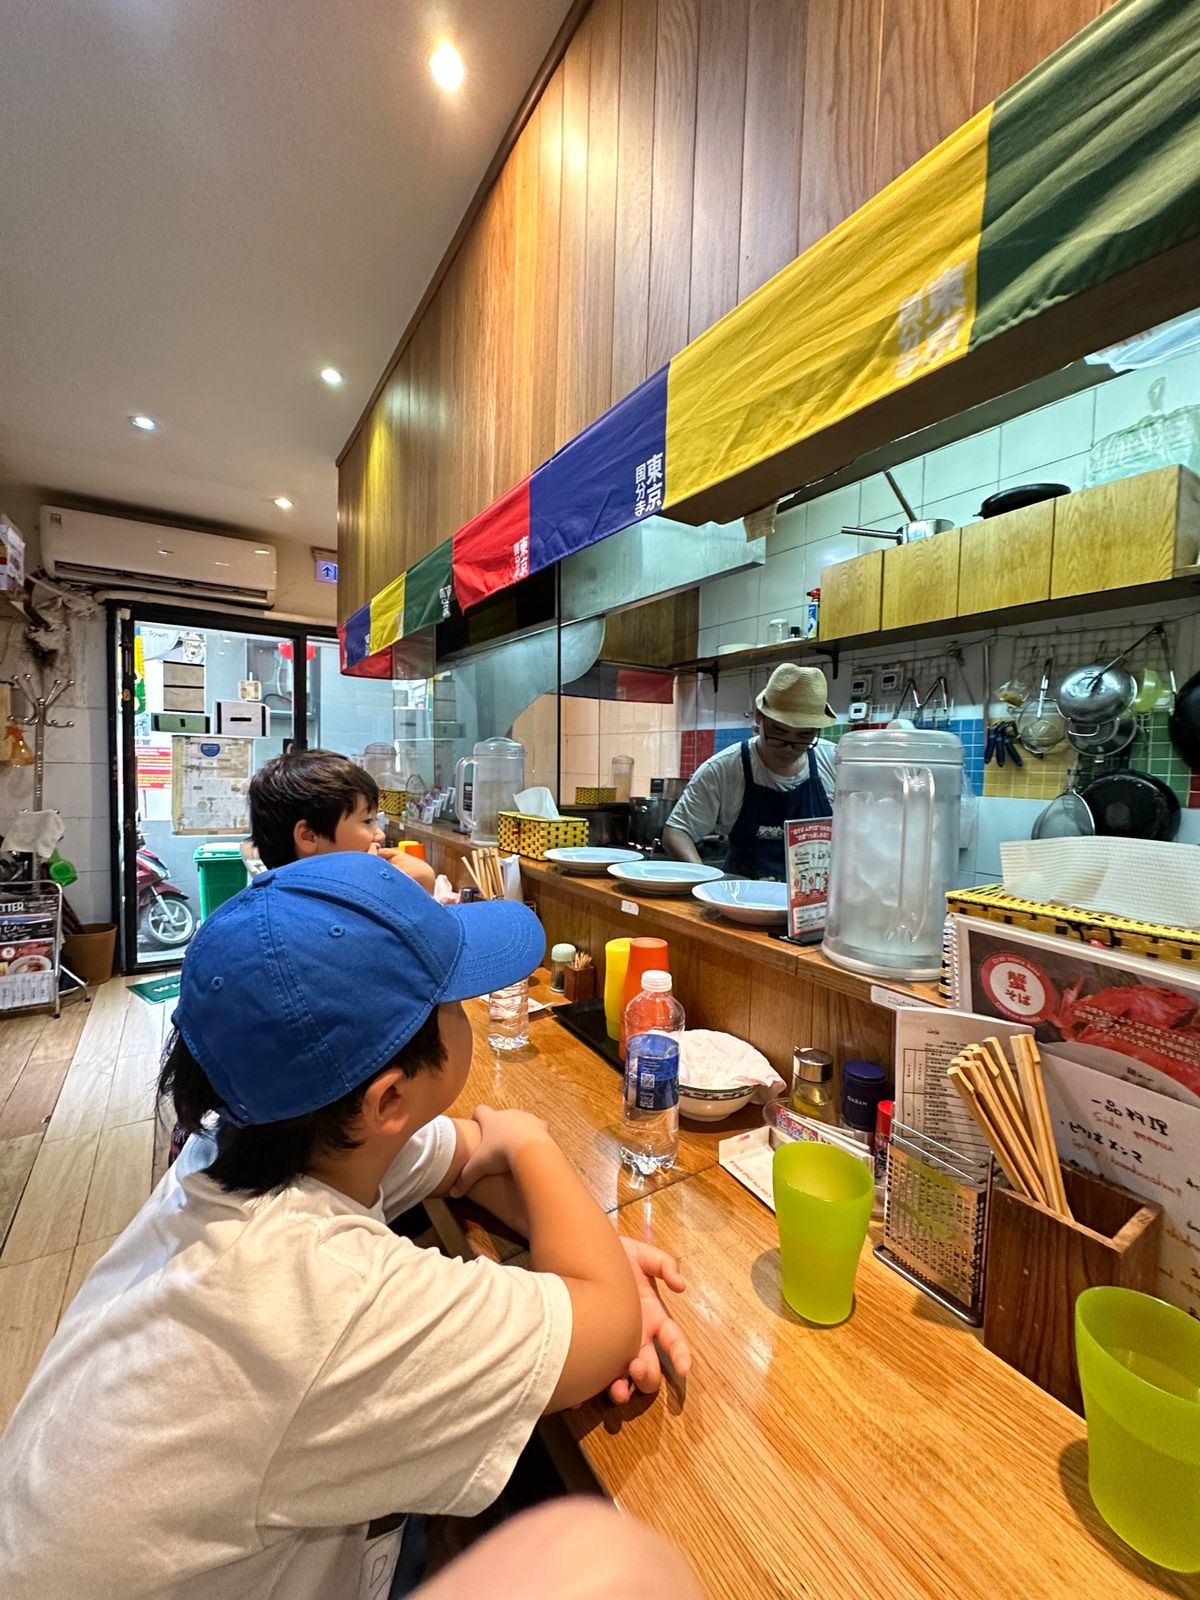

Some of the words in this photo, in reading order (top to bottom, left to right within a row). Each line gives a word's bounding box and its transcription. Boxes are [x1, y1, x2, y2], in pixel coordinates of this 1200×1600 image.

[635, 463, 646, 516] 国分寺
[646, 452, 663, 512] 東京
[1005, 988, 1032, 1007] そば
[1090, 1098, 1169, 1137] 一品料理
